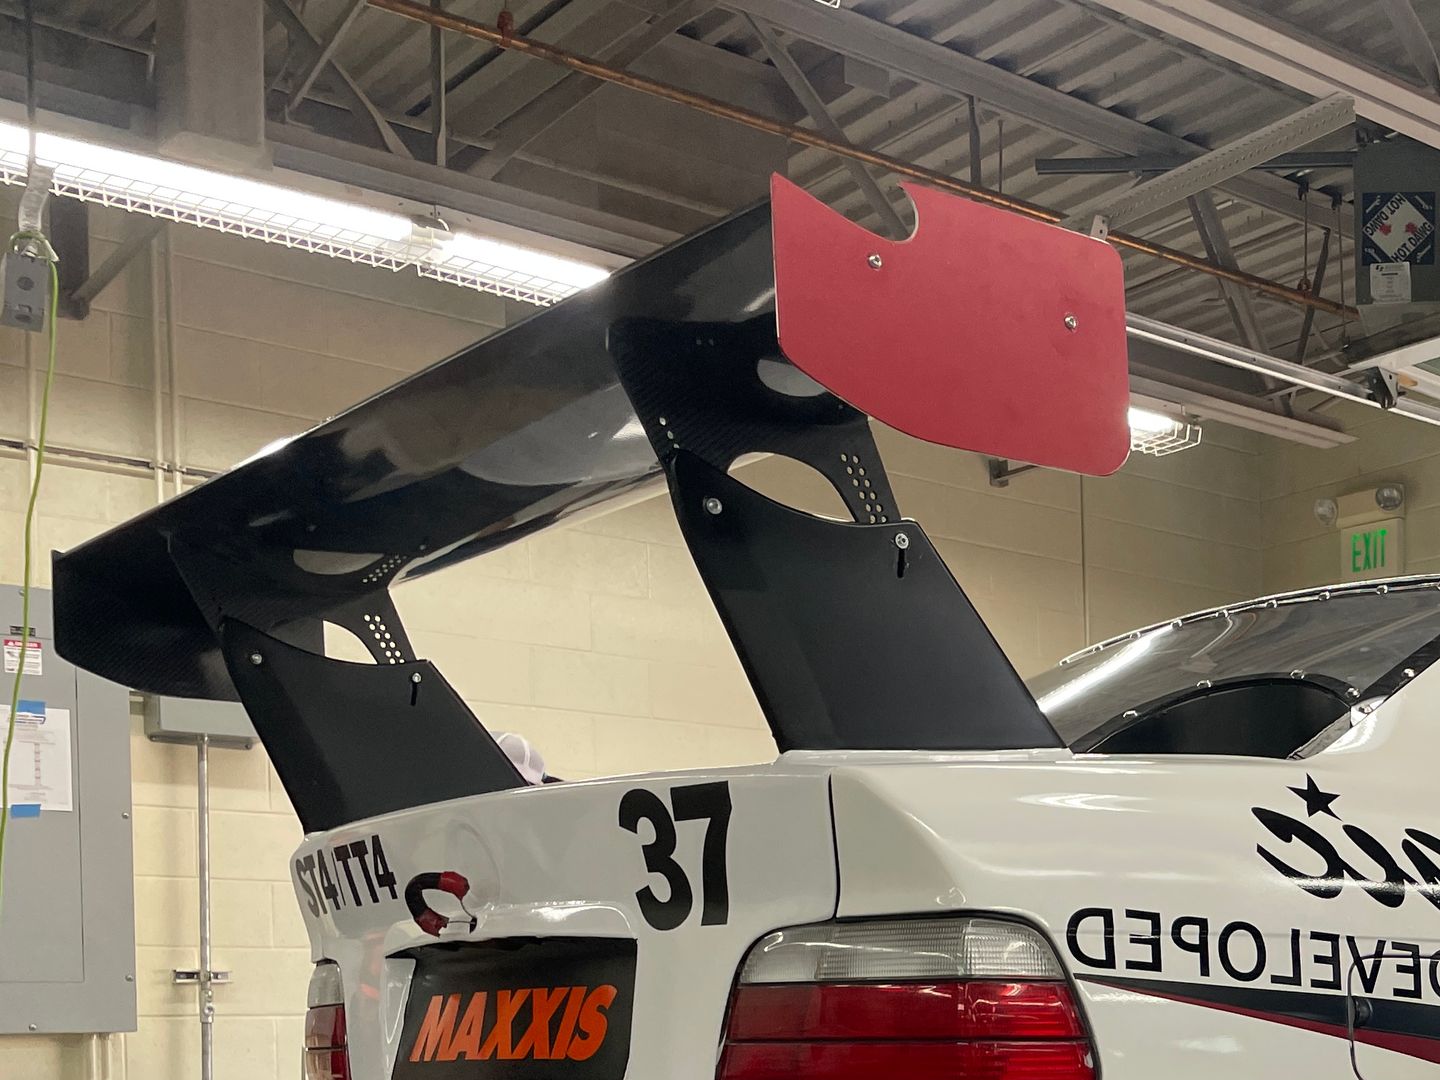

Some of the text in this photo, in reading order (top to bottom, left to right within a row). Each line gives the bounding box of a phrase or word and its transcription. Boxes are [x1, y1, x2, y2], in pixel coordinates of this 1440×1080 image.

[1391, 222, 1432, 262] HOT DAWG
[1351, 528, 1387, 573] EXIT
[294, 834, 398, 918] ST4/TT4
[618, 780, 732, 931] 37
[409, 984, 617, 1062] MAXXIS
